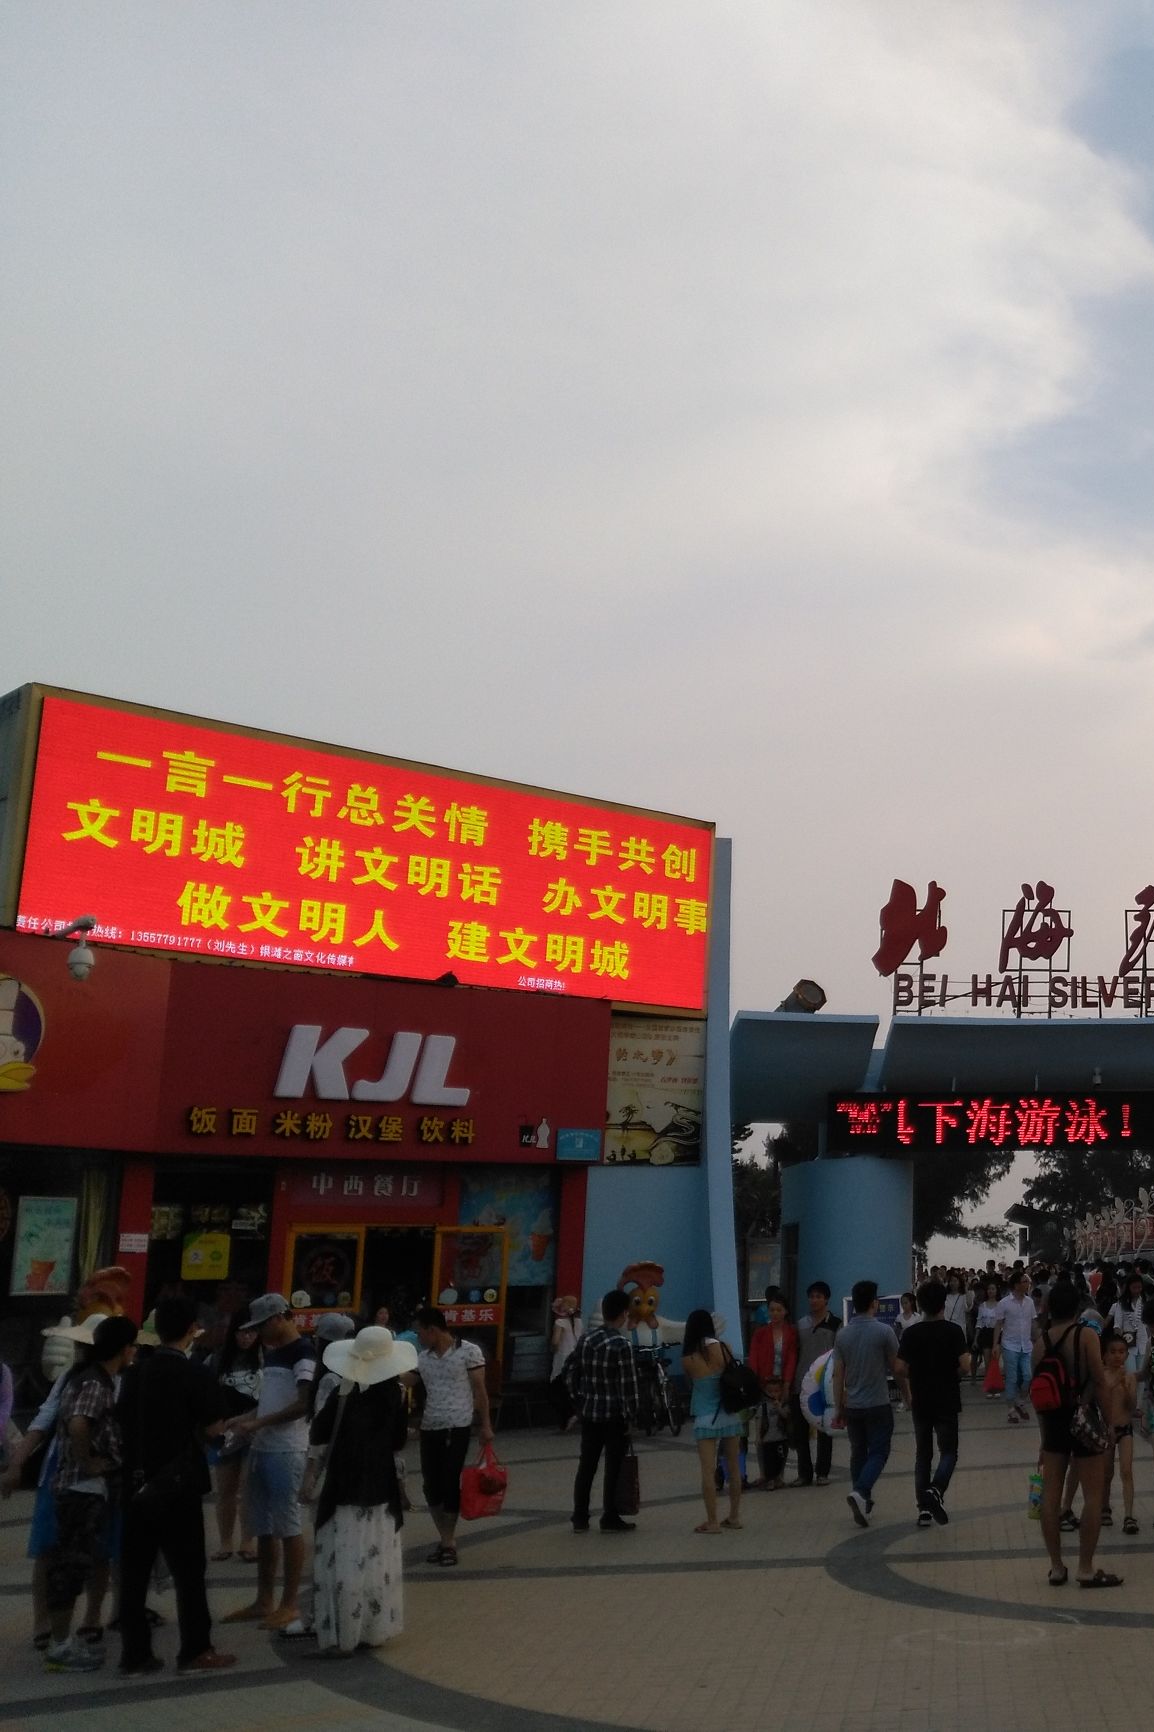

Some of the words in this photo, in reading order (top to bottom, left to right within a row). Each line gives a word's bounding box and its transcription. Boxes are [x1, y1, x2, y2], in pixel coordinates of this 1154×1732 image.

[98, 751, 489, 847] 一言一行总关情
[527, 818, 697, 883] 携手共创
[62, 798, 245, 868] 文明城
[295, 836, 502, 906] 讲文明话
[542, 877, 708, 935] 办文明事
[176, 881, 400, 951] 做文明人
[446, 921, 630, 980] 建文明城
[895, 973, 948, 1007] BEI
[971, 974, 1029, 1008] HAI
[273, 1024, 471, 1107] KJL
[274, 1109, 333, 1140] 米粉
[349, 1113, 403, 1143] 汉堡
[420, 1116, 476, 1144] 饮料
[311, 1171, 423, 1198] 中西餐厅
